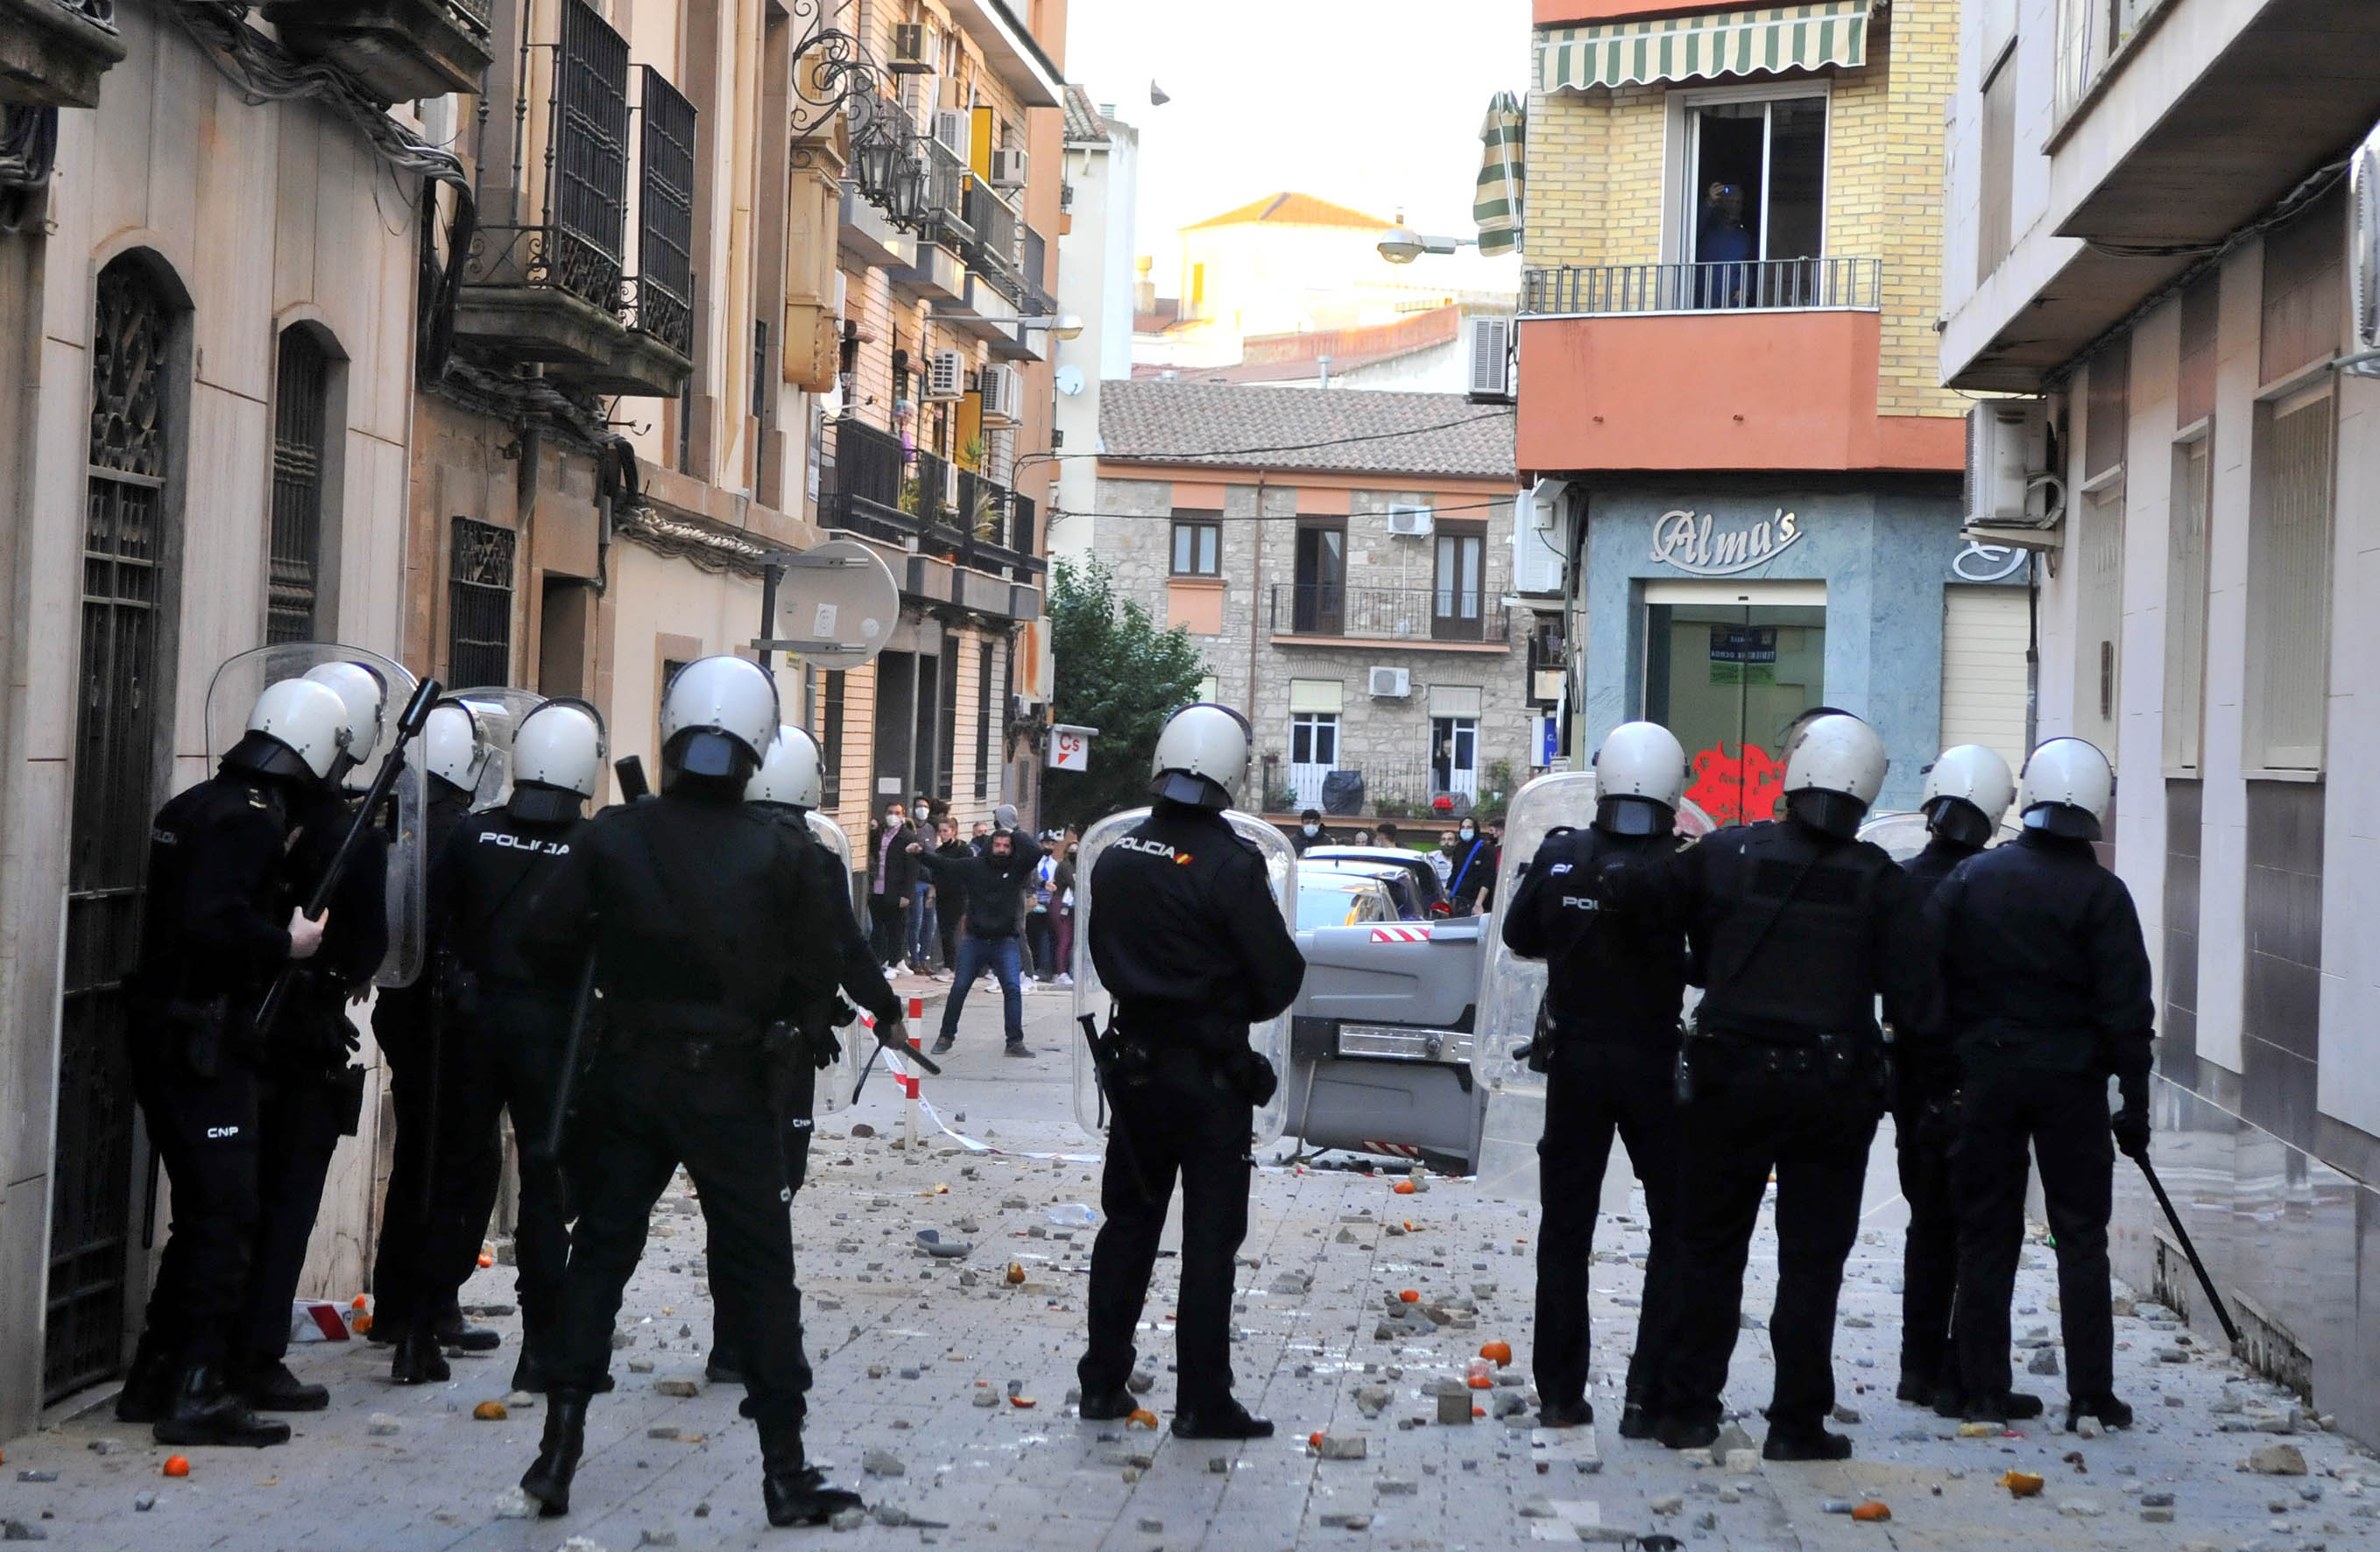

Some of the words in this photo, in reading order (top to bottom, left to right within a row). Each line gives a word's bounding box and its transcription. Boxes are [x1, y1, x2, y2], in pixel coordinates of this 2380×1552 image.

[1650, 508, 1802, 575] Alma's
[1060, 732, 1080, 751] Cs
[1112, 836, 1175, 859] POLICIA
[207, 1125, 239, 1139] CNP
